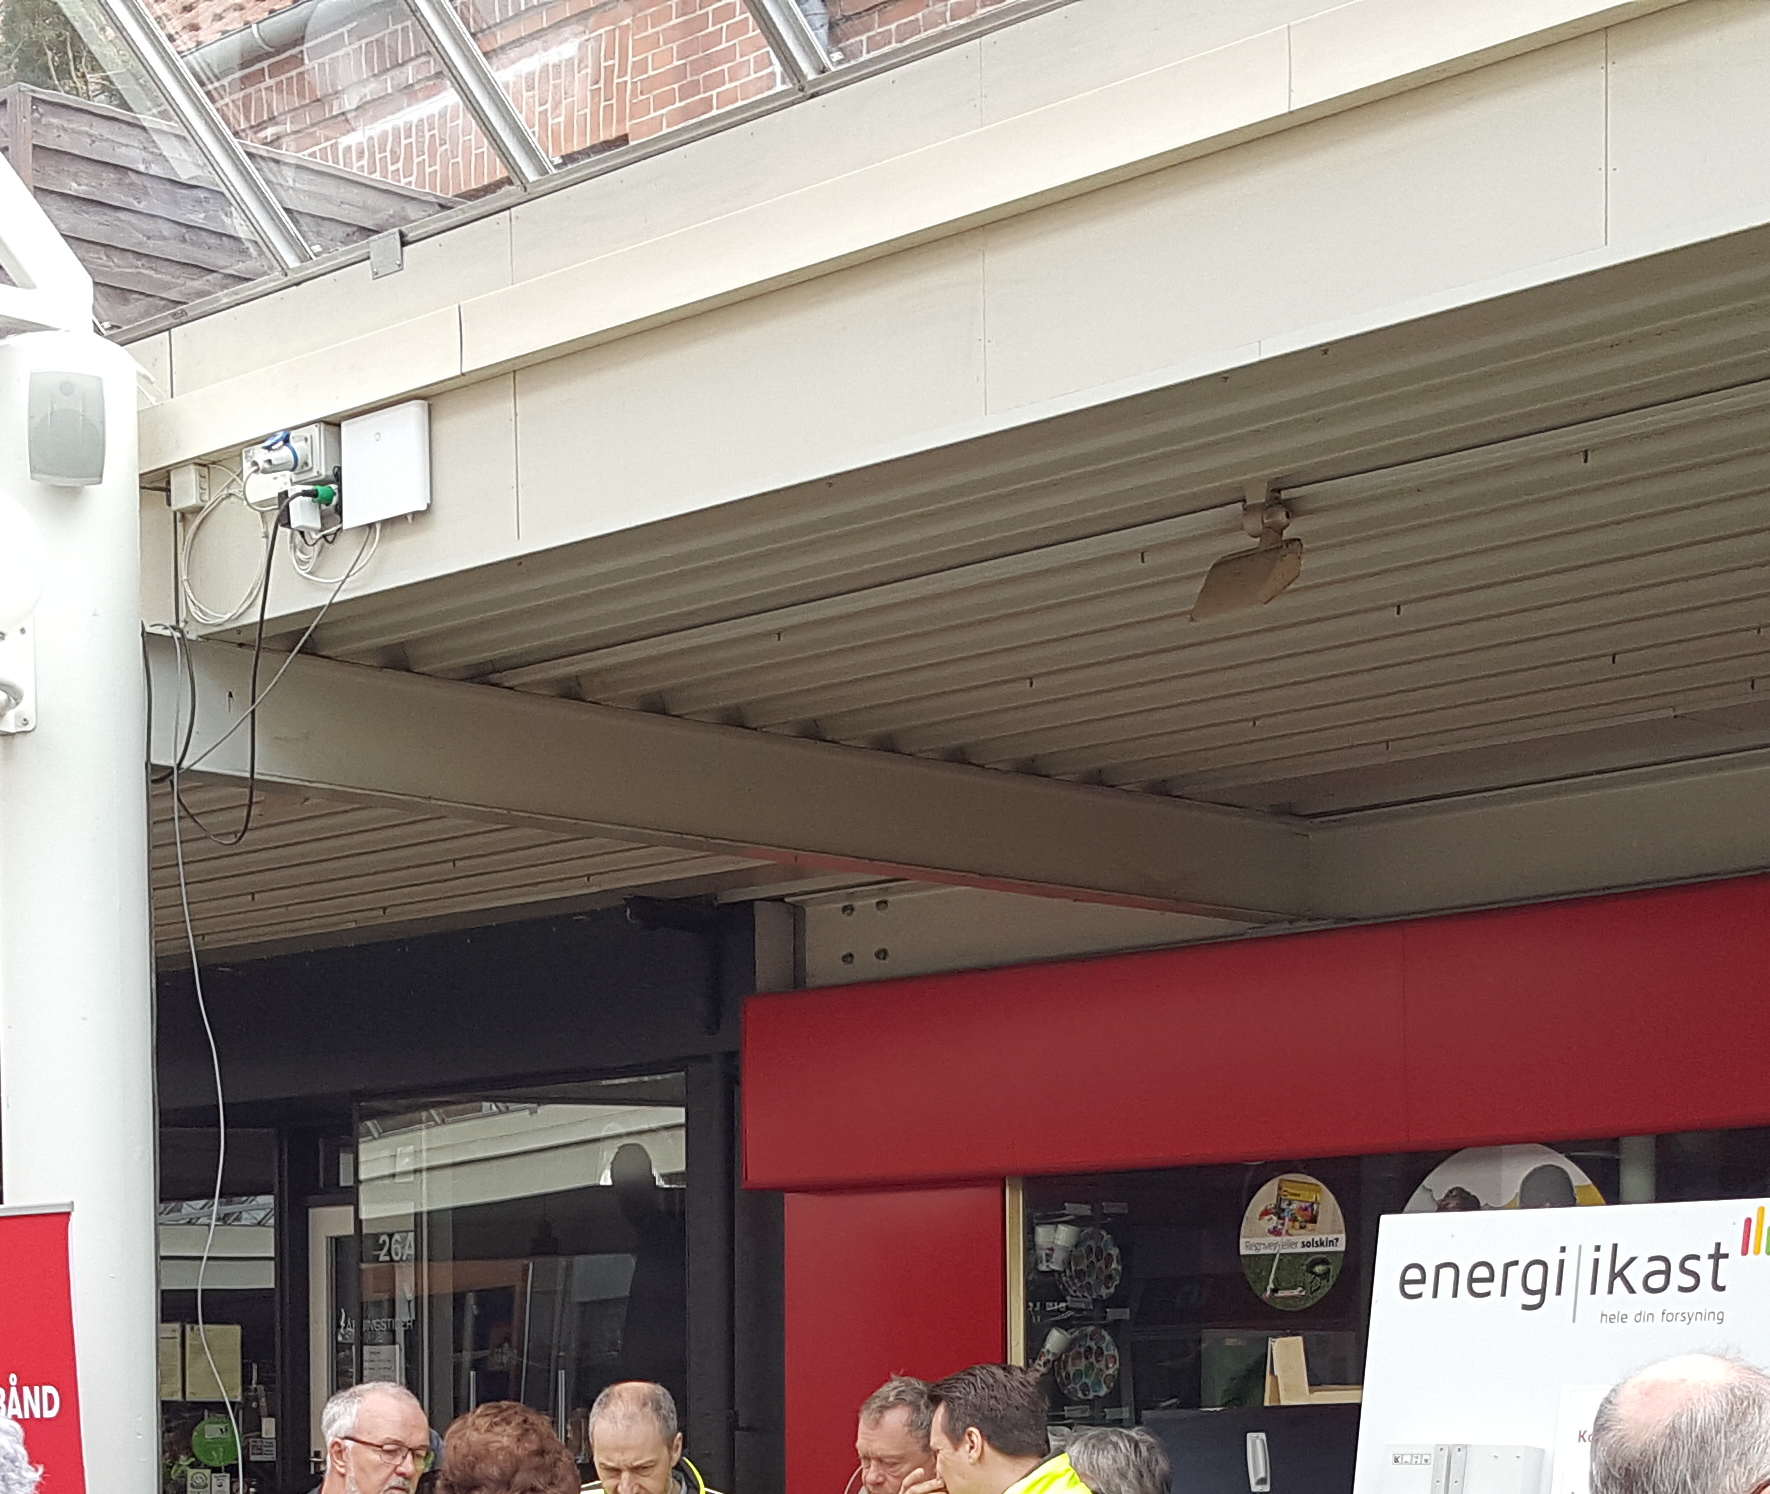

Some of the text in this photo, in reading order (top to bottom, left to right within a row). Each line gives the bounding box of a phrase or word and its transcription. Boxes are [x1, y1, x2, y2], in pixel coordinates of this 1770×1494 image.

[1300, 1236, 1340, 1249] solskin?
[1397, 1241, 1730, 1312] energi ikast
[1599, 1309, 1726, 1326] hele din forsyning
